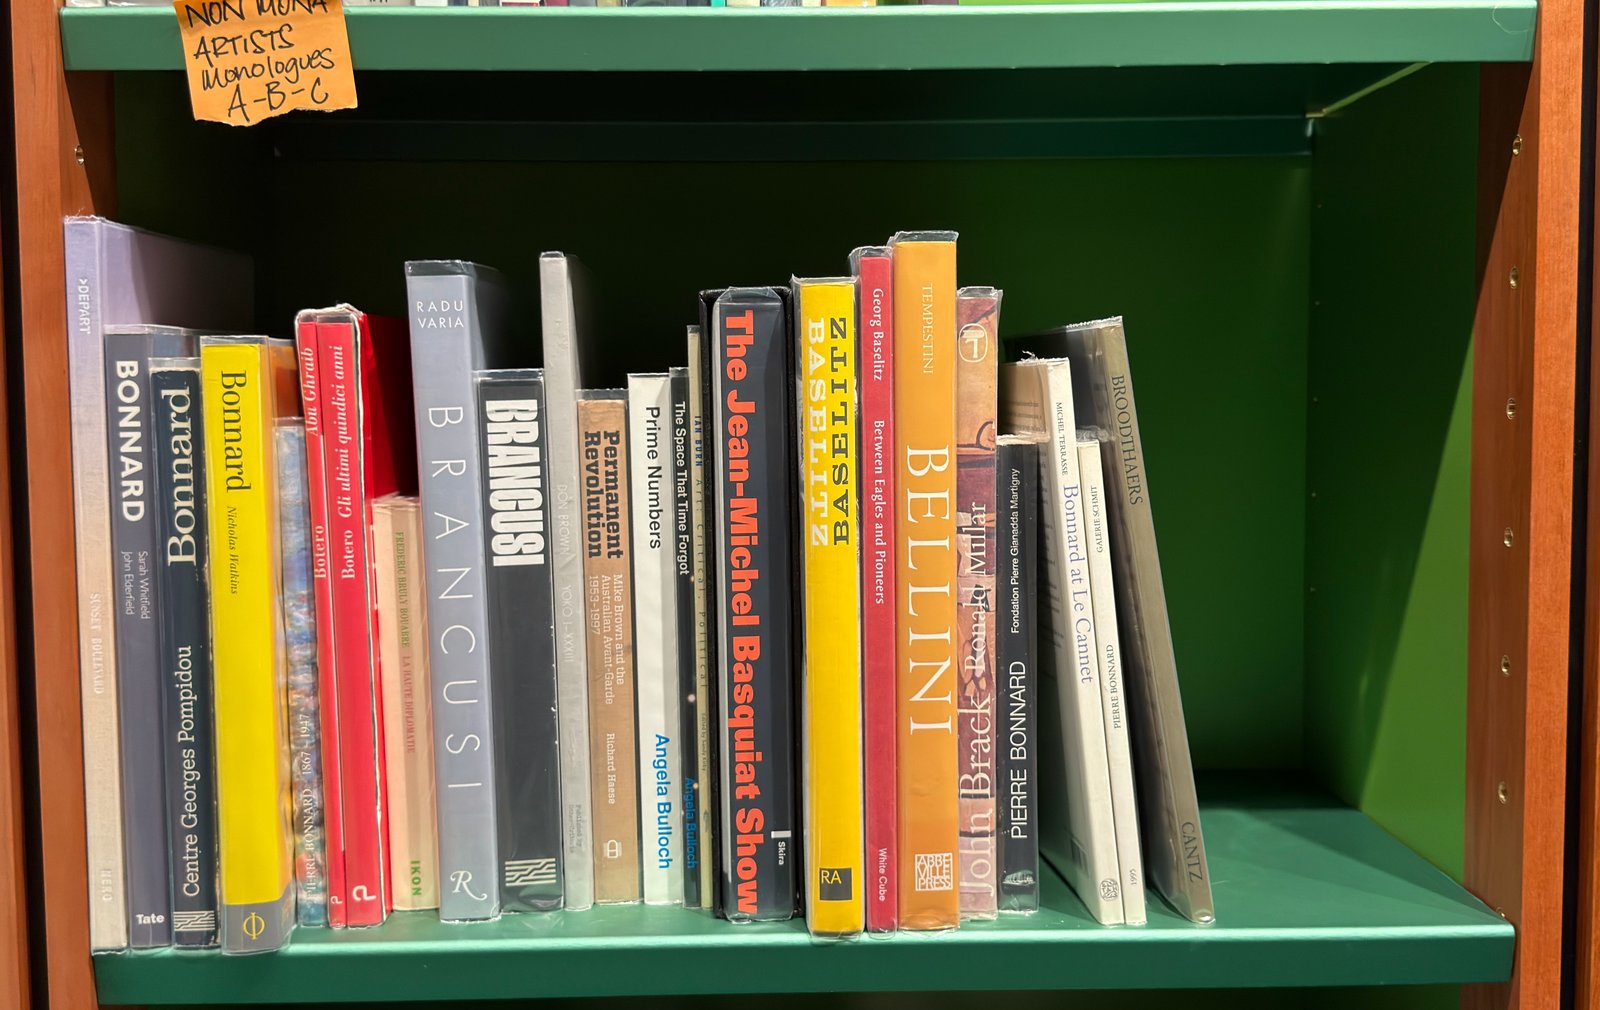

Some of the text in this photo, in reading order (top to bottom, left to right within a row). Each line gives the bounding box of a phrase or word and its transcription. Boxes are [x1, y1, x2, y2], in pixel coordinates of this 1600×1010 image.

[185, 0, 245, 28] NON
[193, 23, 294, 68] ARTISTS
[416, 301, 464, 312] RADU
[417, 317, 464, 328] VARIA
[922, 283, 934, 374] TEMPESTINI
[115, 360, 145, 522] BONNARD
[329, 345, 356, 579] Botero Gli ultimi quindici anni
[694, 416, 702, 434] IAN
[694, 440, 702, 467] BURN
[808, 318, 828, 546] BASELITZ
[830, 317, 849, 546] BASELITZ
[870, 288, 886, 604] Georg Baselitz Between Eagles and Pioneers
[1112, 375, 1144, 506] BROODTHAERS
[160, 386, 197, 566] Bonnard
[220, 370, 252, 594] Bonnard Nicholas Watkins
[302, 348, 327, 579] Botero Abu Ghraib
[486, 399, 544, 566] BRANCUSI
[557, 484, 568, 509] DON
[584, 431, 605, 558] Revolution
[604, 430, 624, 558] Permanent
[646, 406, 664, 549] Prime Numbers
[674, 401, 690, 575] The Space That Time Forgot
[1090, 486, 1100, 516] SCHMIT
[558, 515, 570, 555] BROWN
[1056, 402, 1094, 684] MICHEL TERRASSE Bonnard at Le Cannet
[1094, 518, 1104, 553] GALERIE
[122, 550, 135, 614] John Elderfield
[138, 551, 150, 619] Sarah Whitfield
[428, 406, 482, 787] BRANCUSI
[562, 585, 573, 616] YOKO
[589, 575, 600, 634] 1953-1997
[726, 310, 764, 914] The Jean-Michel Basquiat Show
[907, 444, 952, 736] BELLINI
[89, 593, 105, 694] SUNSET BOULEVARD
[395, 532, 416, 753] FREDERIC BRULY BOUABRE LA HAUTE DIPLOMATIE
[602, 574, 615, 704] Australian Avant-Garde
[612, 574, 626, 685] Mike Brown and the
[698, 612, 708, 687] Political
[1010, 468, 1028, 839] PIERRE BONNARD Fondation Pierre Gianadda Martigny
[958, 502, 994, 896] John Brack Ronald Millar
[1106, 644, 1118, 694] BONNARD
[299, 714, 311, 738] 1947
[1111, 696, 1121, 729] PIERRE
[174, 646, 201, 896] Centre Georges Pompidou
[300, 752, 312, 775] 1867
[606, 733, 617, 804] Richard Haese
[302, 788, 316, 850] BONNARD
[652, 734, 673, 869] Angela Bulloch
[683, 778, 698, 869] Angela Bulloch
[100, 869, 112, 901] NERO
[410, 860, 422, 896] IKON
[778, 841, 786, 865] Skira
[820, 870, 842, 884] RA
[878, 848, 888, 901] White Cube
[918, 878, 950, 890] PRESS
[1182, 822, 1202, 882] CANTZ
[136, 913, 165, 925] Tate
